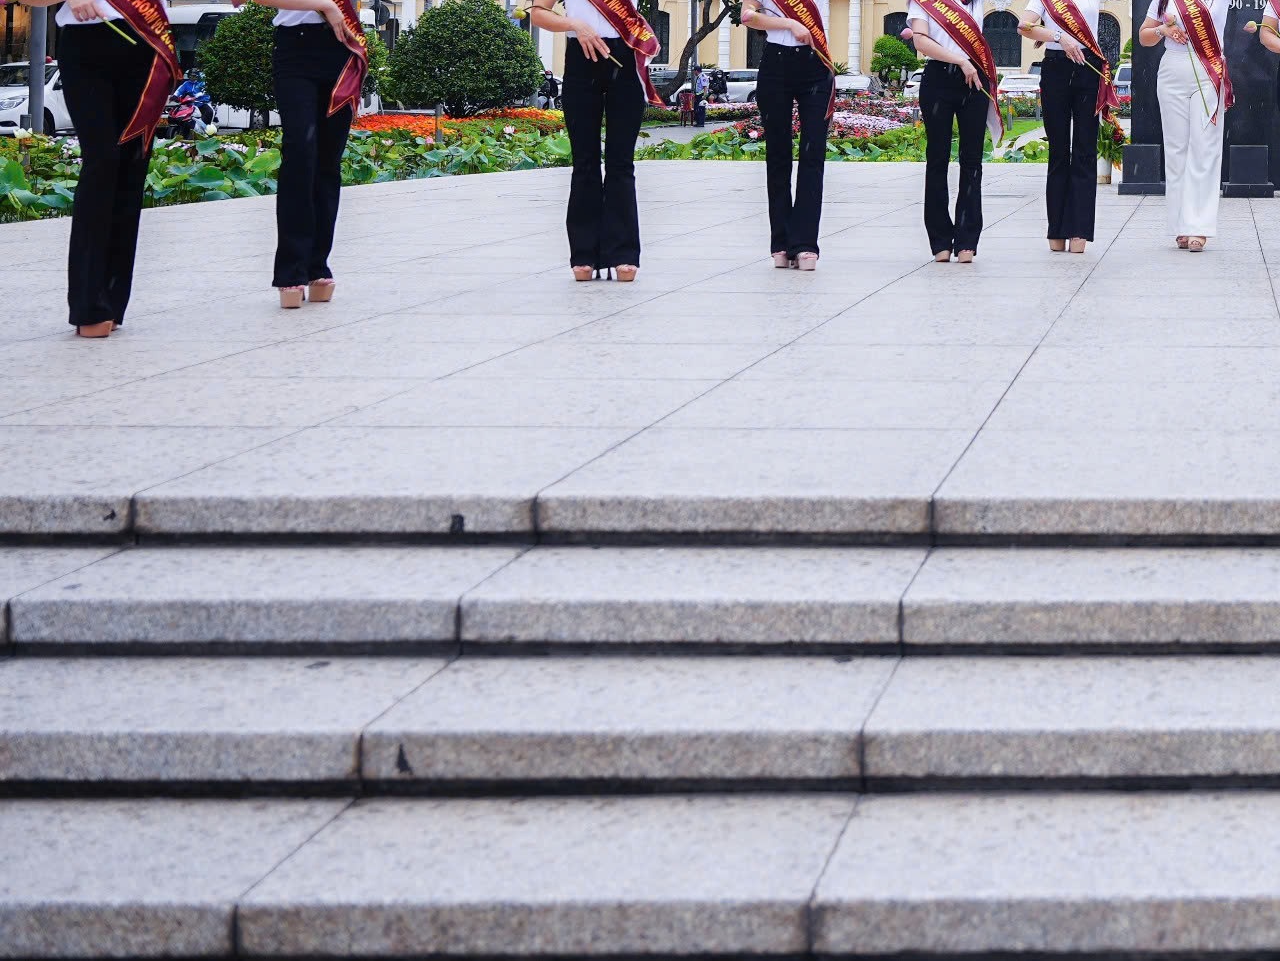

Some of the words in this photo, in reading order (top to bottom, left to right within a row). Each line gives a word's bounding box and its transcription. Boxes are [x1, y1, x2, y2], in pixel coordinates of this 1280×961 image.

[793, 3, 815, 28] DOANH
[1229, 0, 1243, 10] 90
[1254, 0, 1267, 10] 19
[932, 0, 948, 16] HOA
[956, 20, 978, 45] DOANH
[1191, 17, 1209, 41] DOANH
